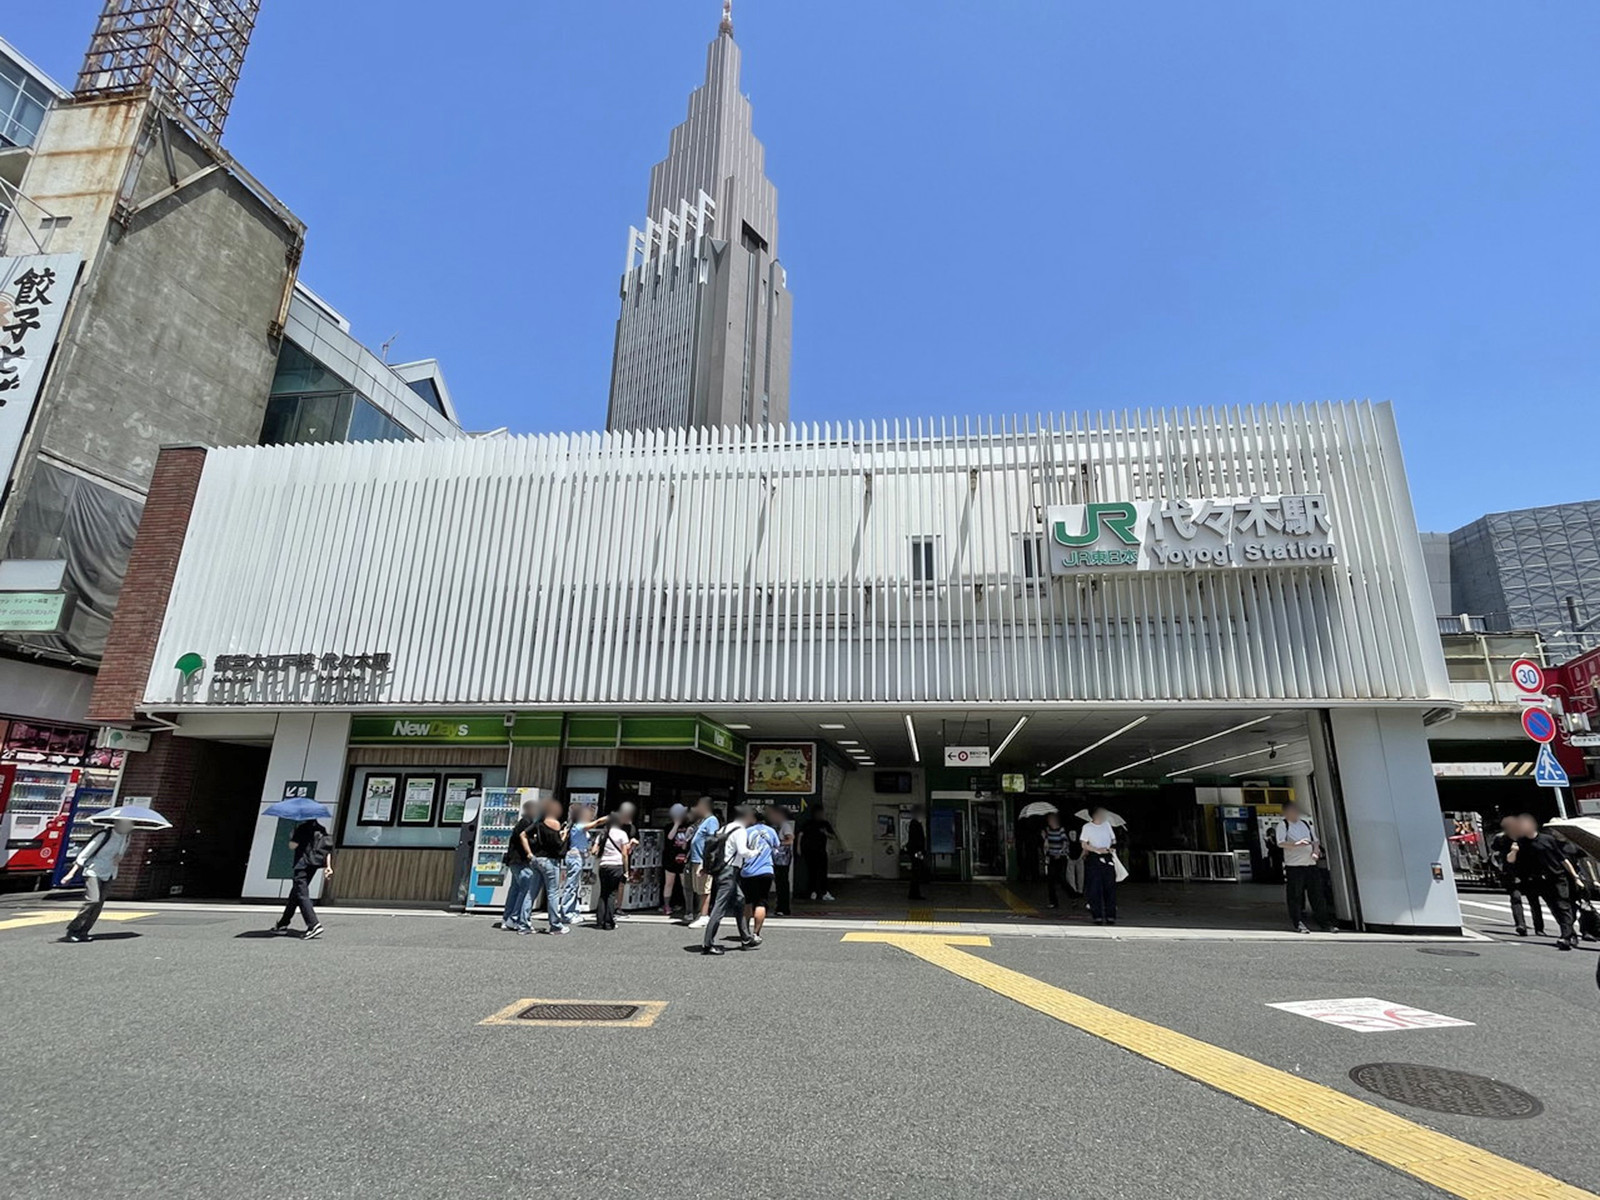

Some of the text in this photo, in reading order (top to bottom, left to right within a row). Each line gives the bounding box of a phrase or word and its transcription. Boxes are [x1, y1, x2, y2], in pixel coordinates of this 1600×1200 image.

[1053, 502, 1141, 547] JR
[1148, 494, 1332, 541] 代々木駅
[1062, 549, 1137, 567] JR東日本
[1152, 541, 1335, 567] Yoyogi Station
[1518, 669, 1537, 685] 30
[392, 720, 469, 738] NewDays
